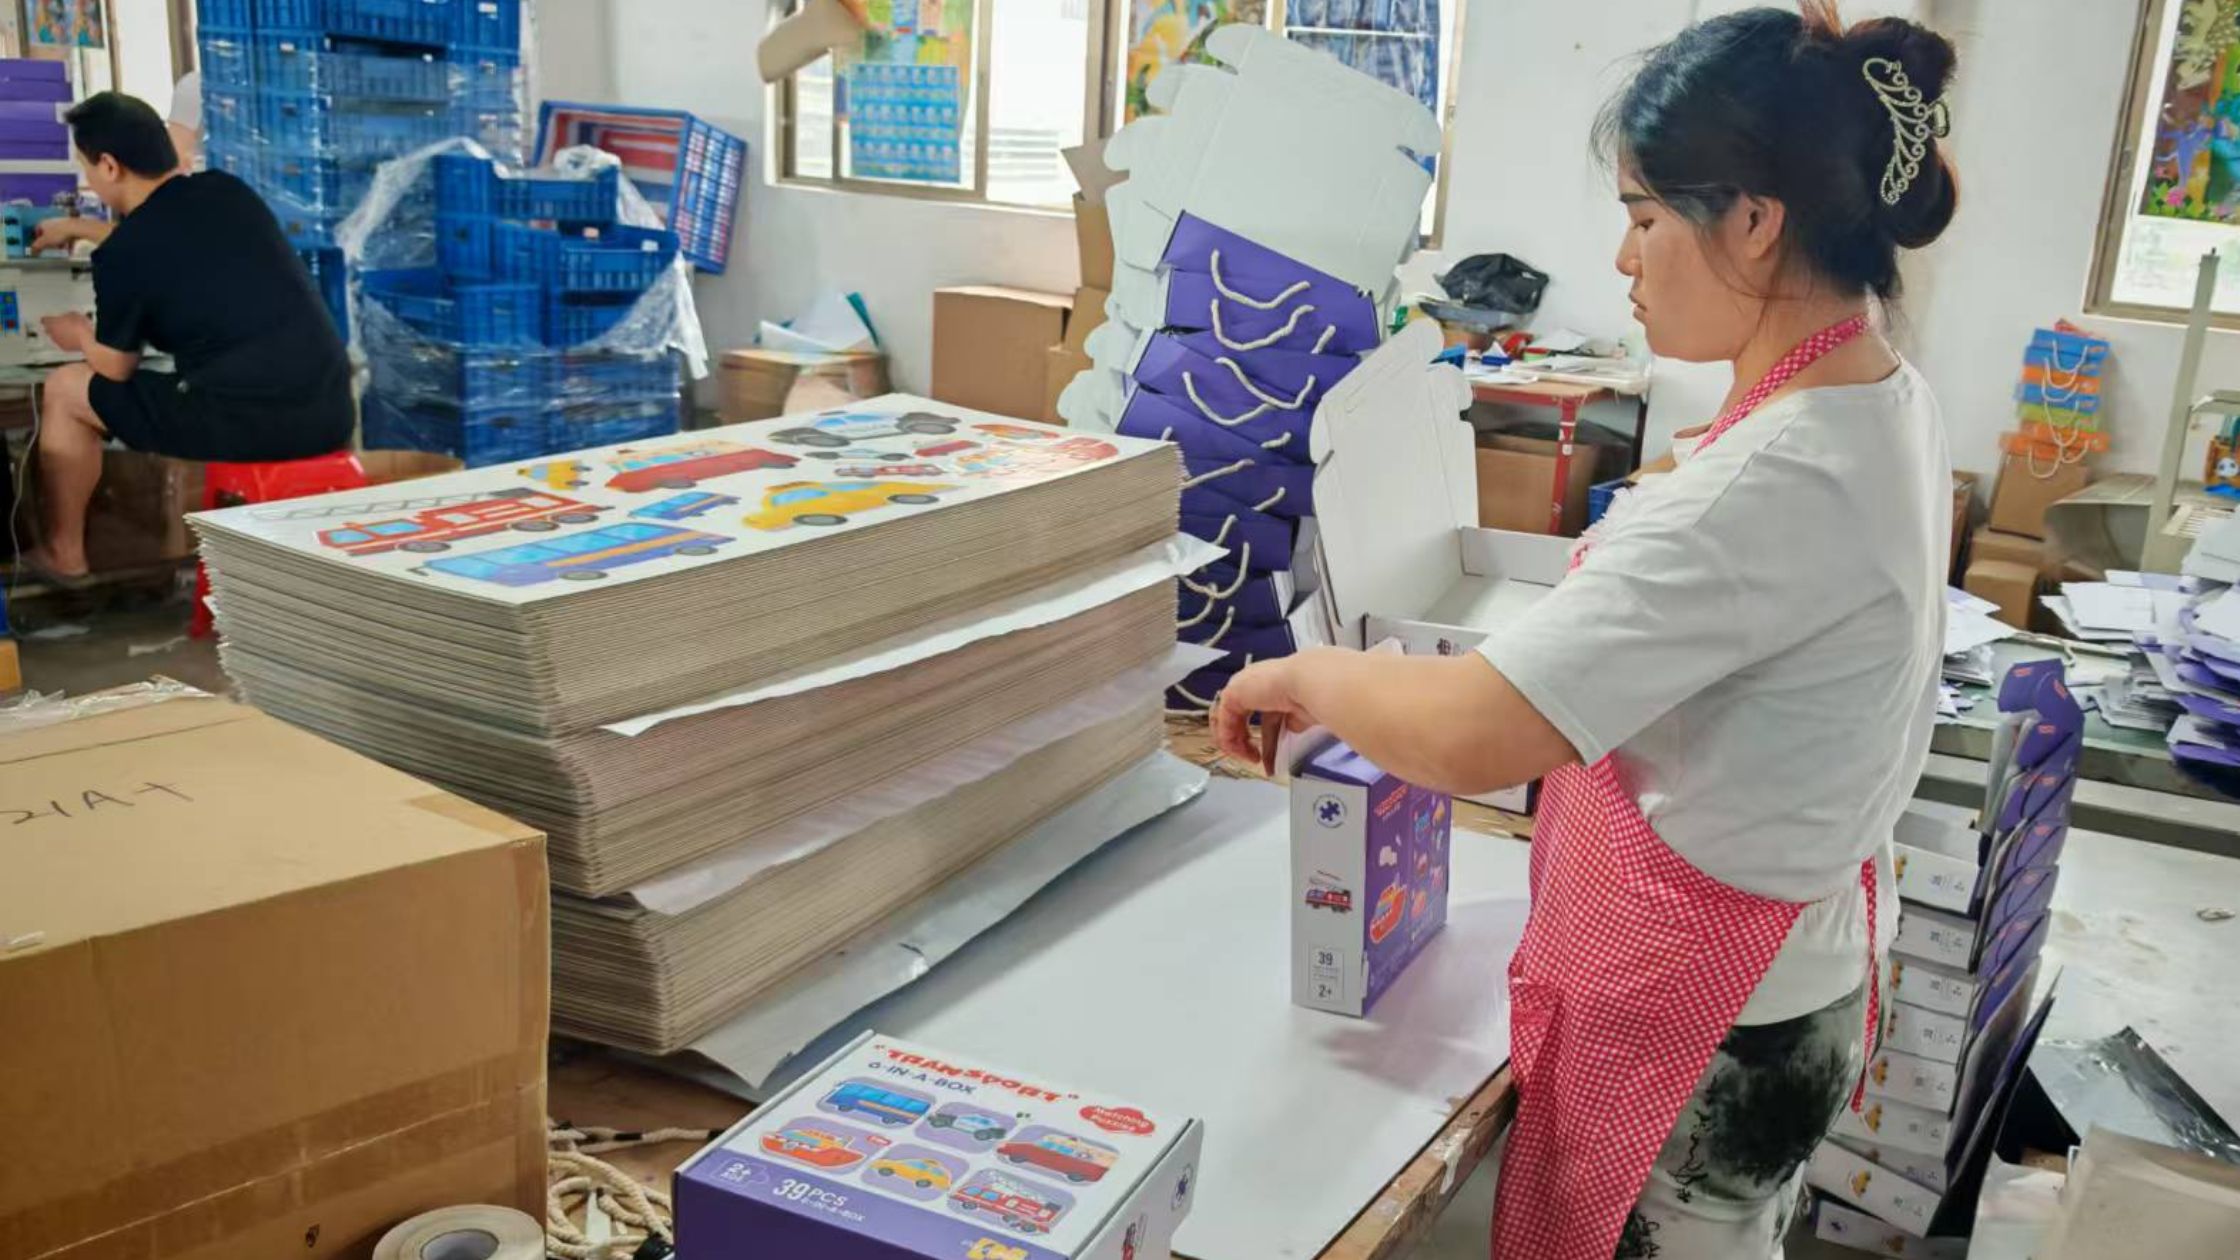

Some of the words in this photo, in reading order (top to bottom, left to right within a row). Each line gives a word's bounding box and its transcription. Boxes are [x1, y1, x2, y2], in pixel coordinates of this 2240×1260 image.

[1318, 951, 1334, 966] 39
[1318, 984, 1332, 998] 2+
[772, 1178, 810, 1201] 39
[807, 1187, 847, 1207] PCS
